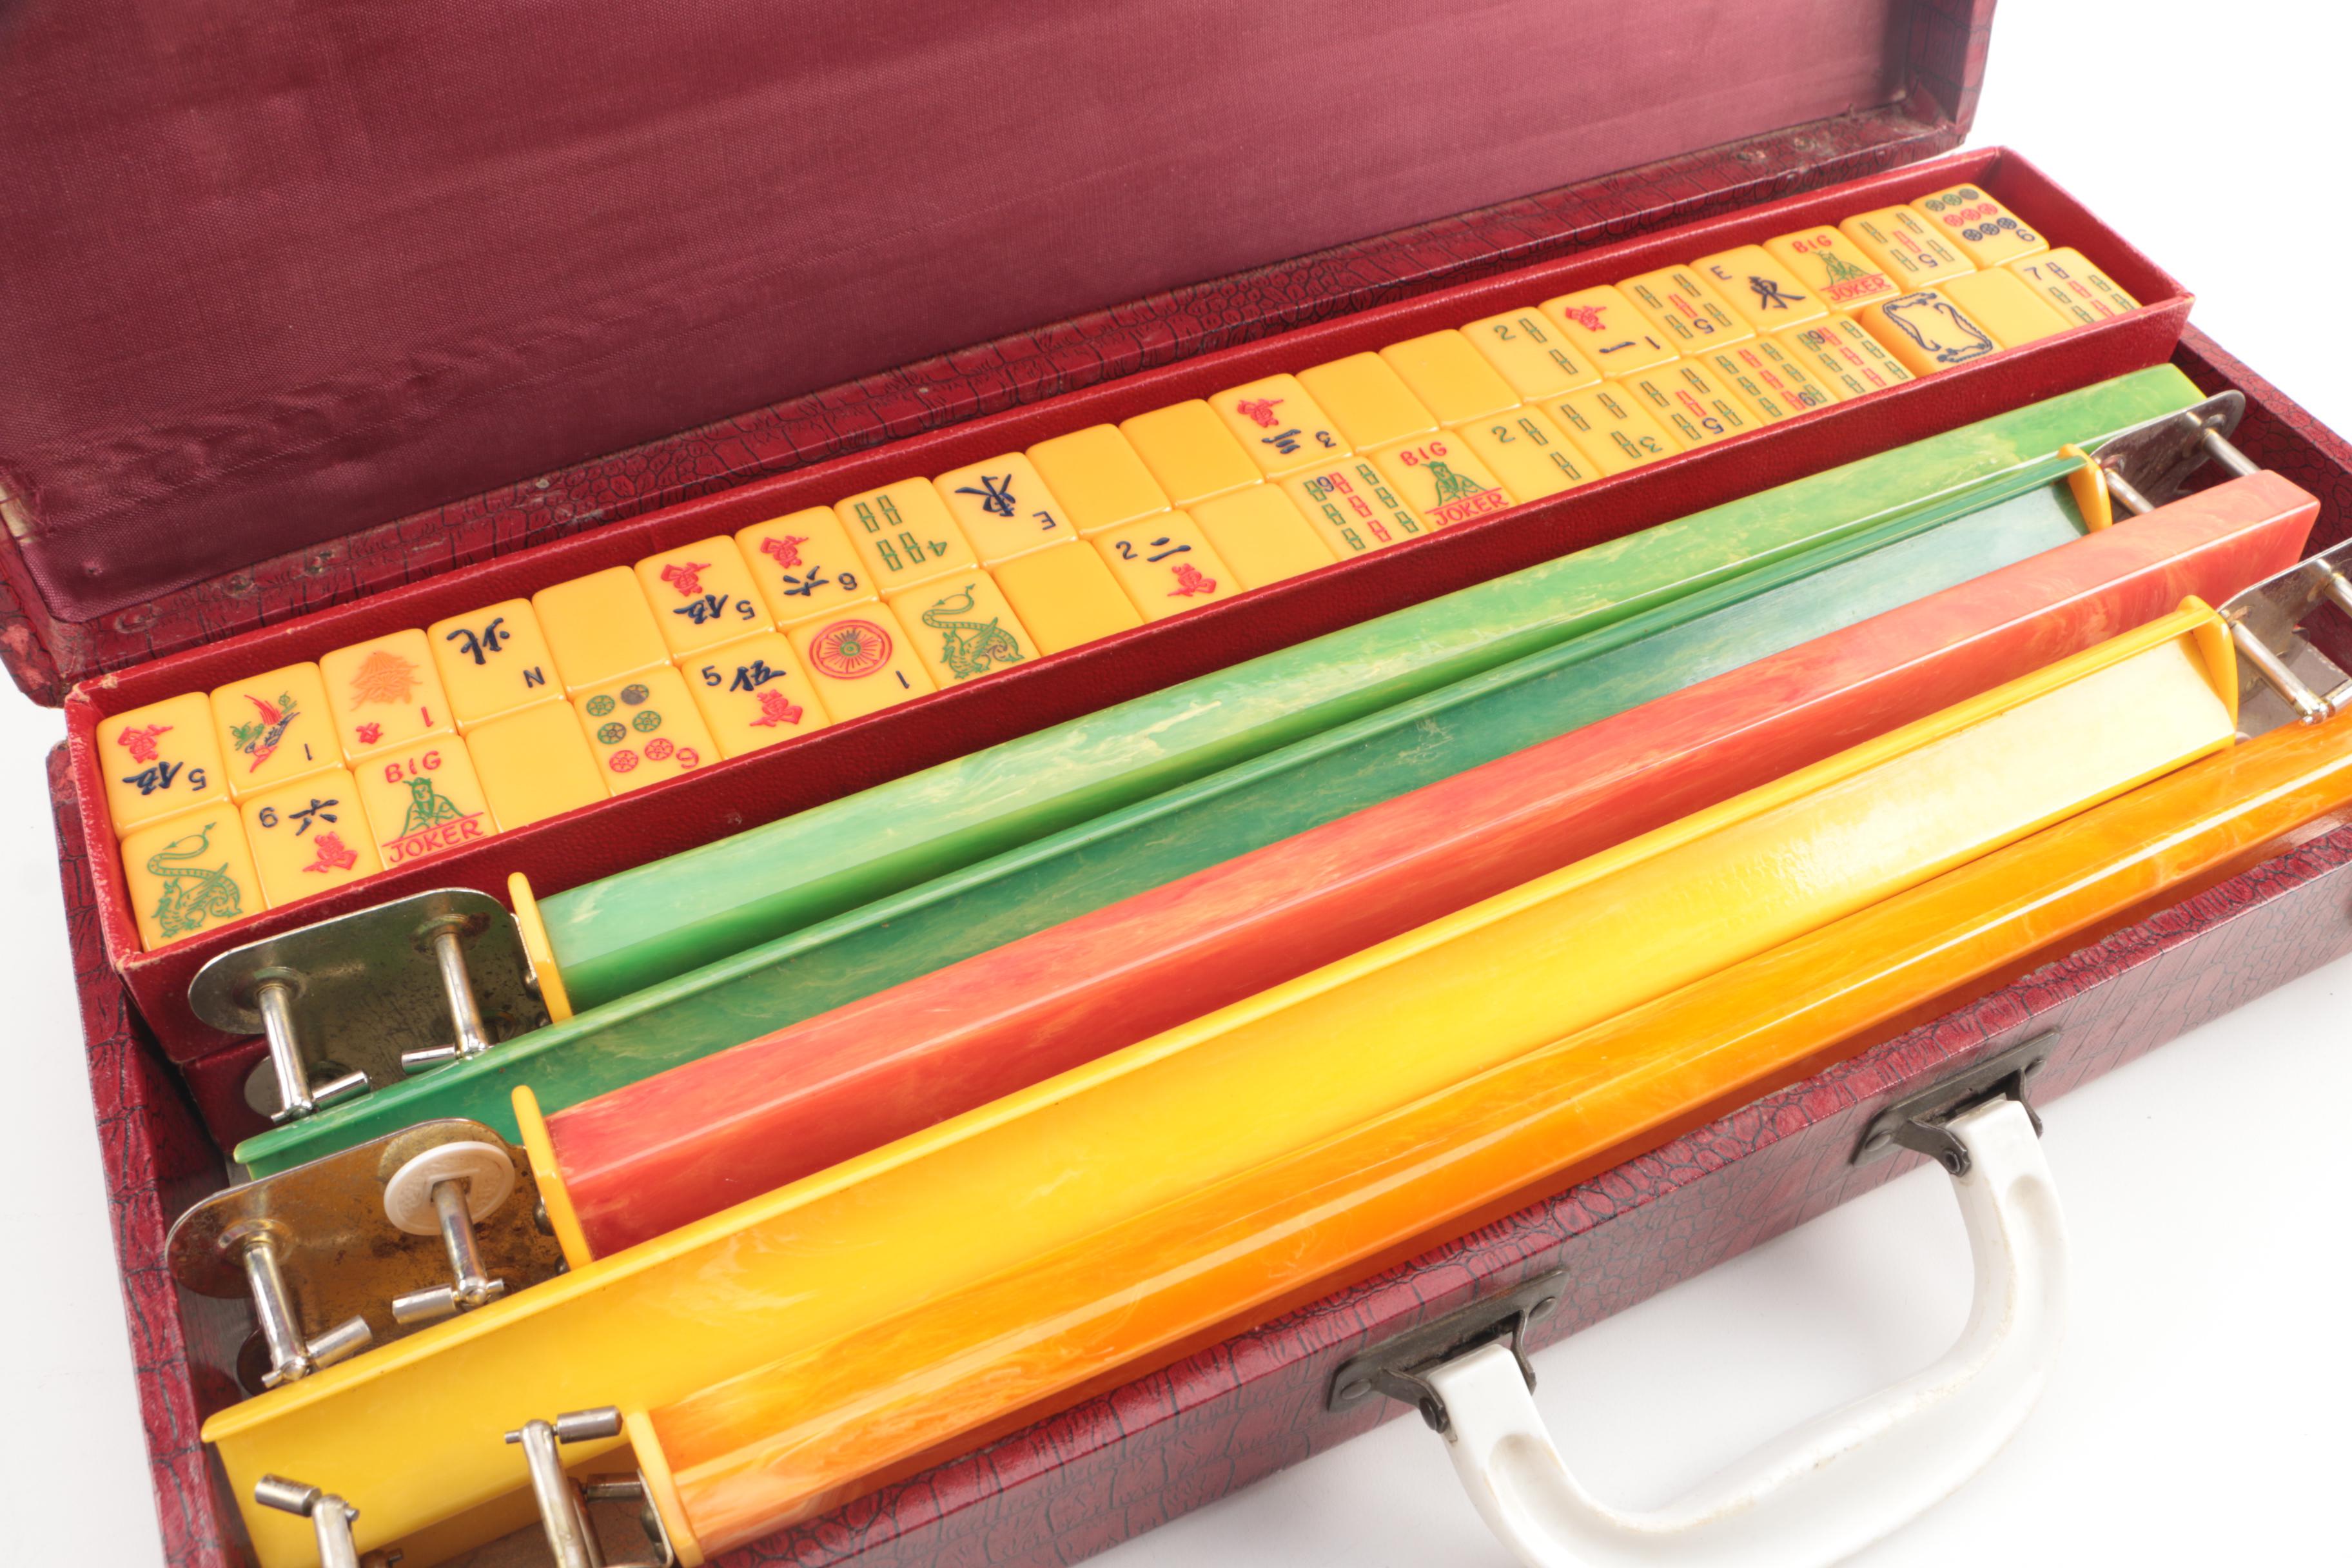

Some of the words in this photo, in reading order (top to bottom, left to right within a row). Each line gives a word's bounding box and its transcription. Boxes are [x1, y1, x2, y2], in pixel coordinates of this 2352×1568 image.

[1792, 235, 1832, 253] BIG
[1709, 264, 1733, 281] E
[2025, 267, 2041, 280] 7
[1748, 277, 1805, 310] 東
[1829, 277, 1891, 302] JOKER
[1493, 325, 1515, 342] 2
[1694, 319, 1714, 333] 5
[1491, 426, 1515, 444] 2
[1701, 417, 1725, 435] 5
[1315, 431, 1336, 448] 3
[1400, 442, 1447, 467] BIG
[1316, 476, 1335, 493] 9
[954, 474, 1016, 517] 東
[1436, 493, 1509, 526] JOKER
[1032, 509, 1057, 531] E
[928, 540, 948, 557] 4
[1115, 541, 1138, 560] 2
[736, 600, 755, 620] 5
[524, 667, 545, 688] N
[701, 665, 722, 687] 5
[385, 751, 442, 783] BIG
[188, 769, 206, 791] 5
[389, 819, 484, 863] JOKER
